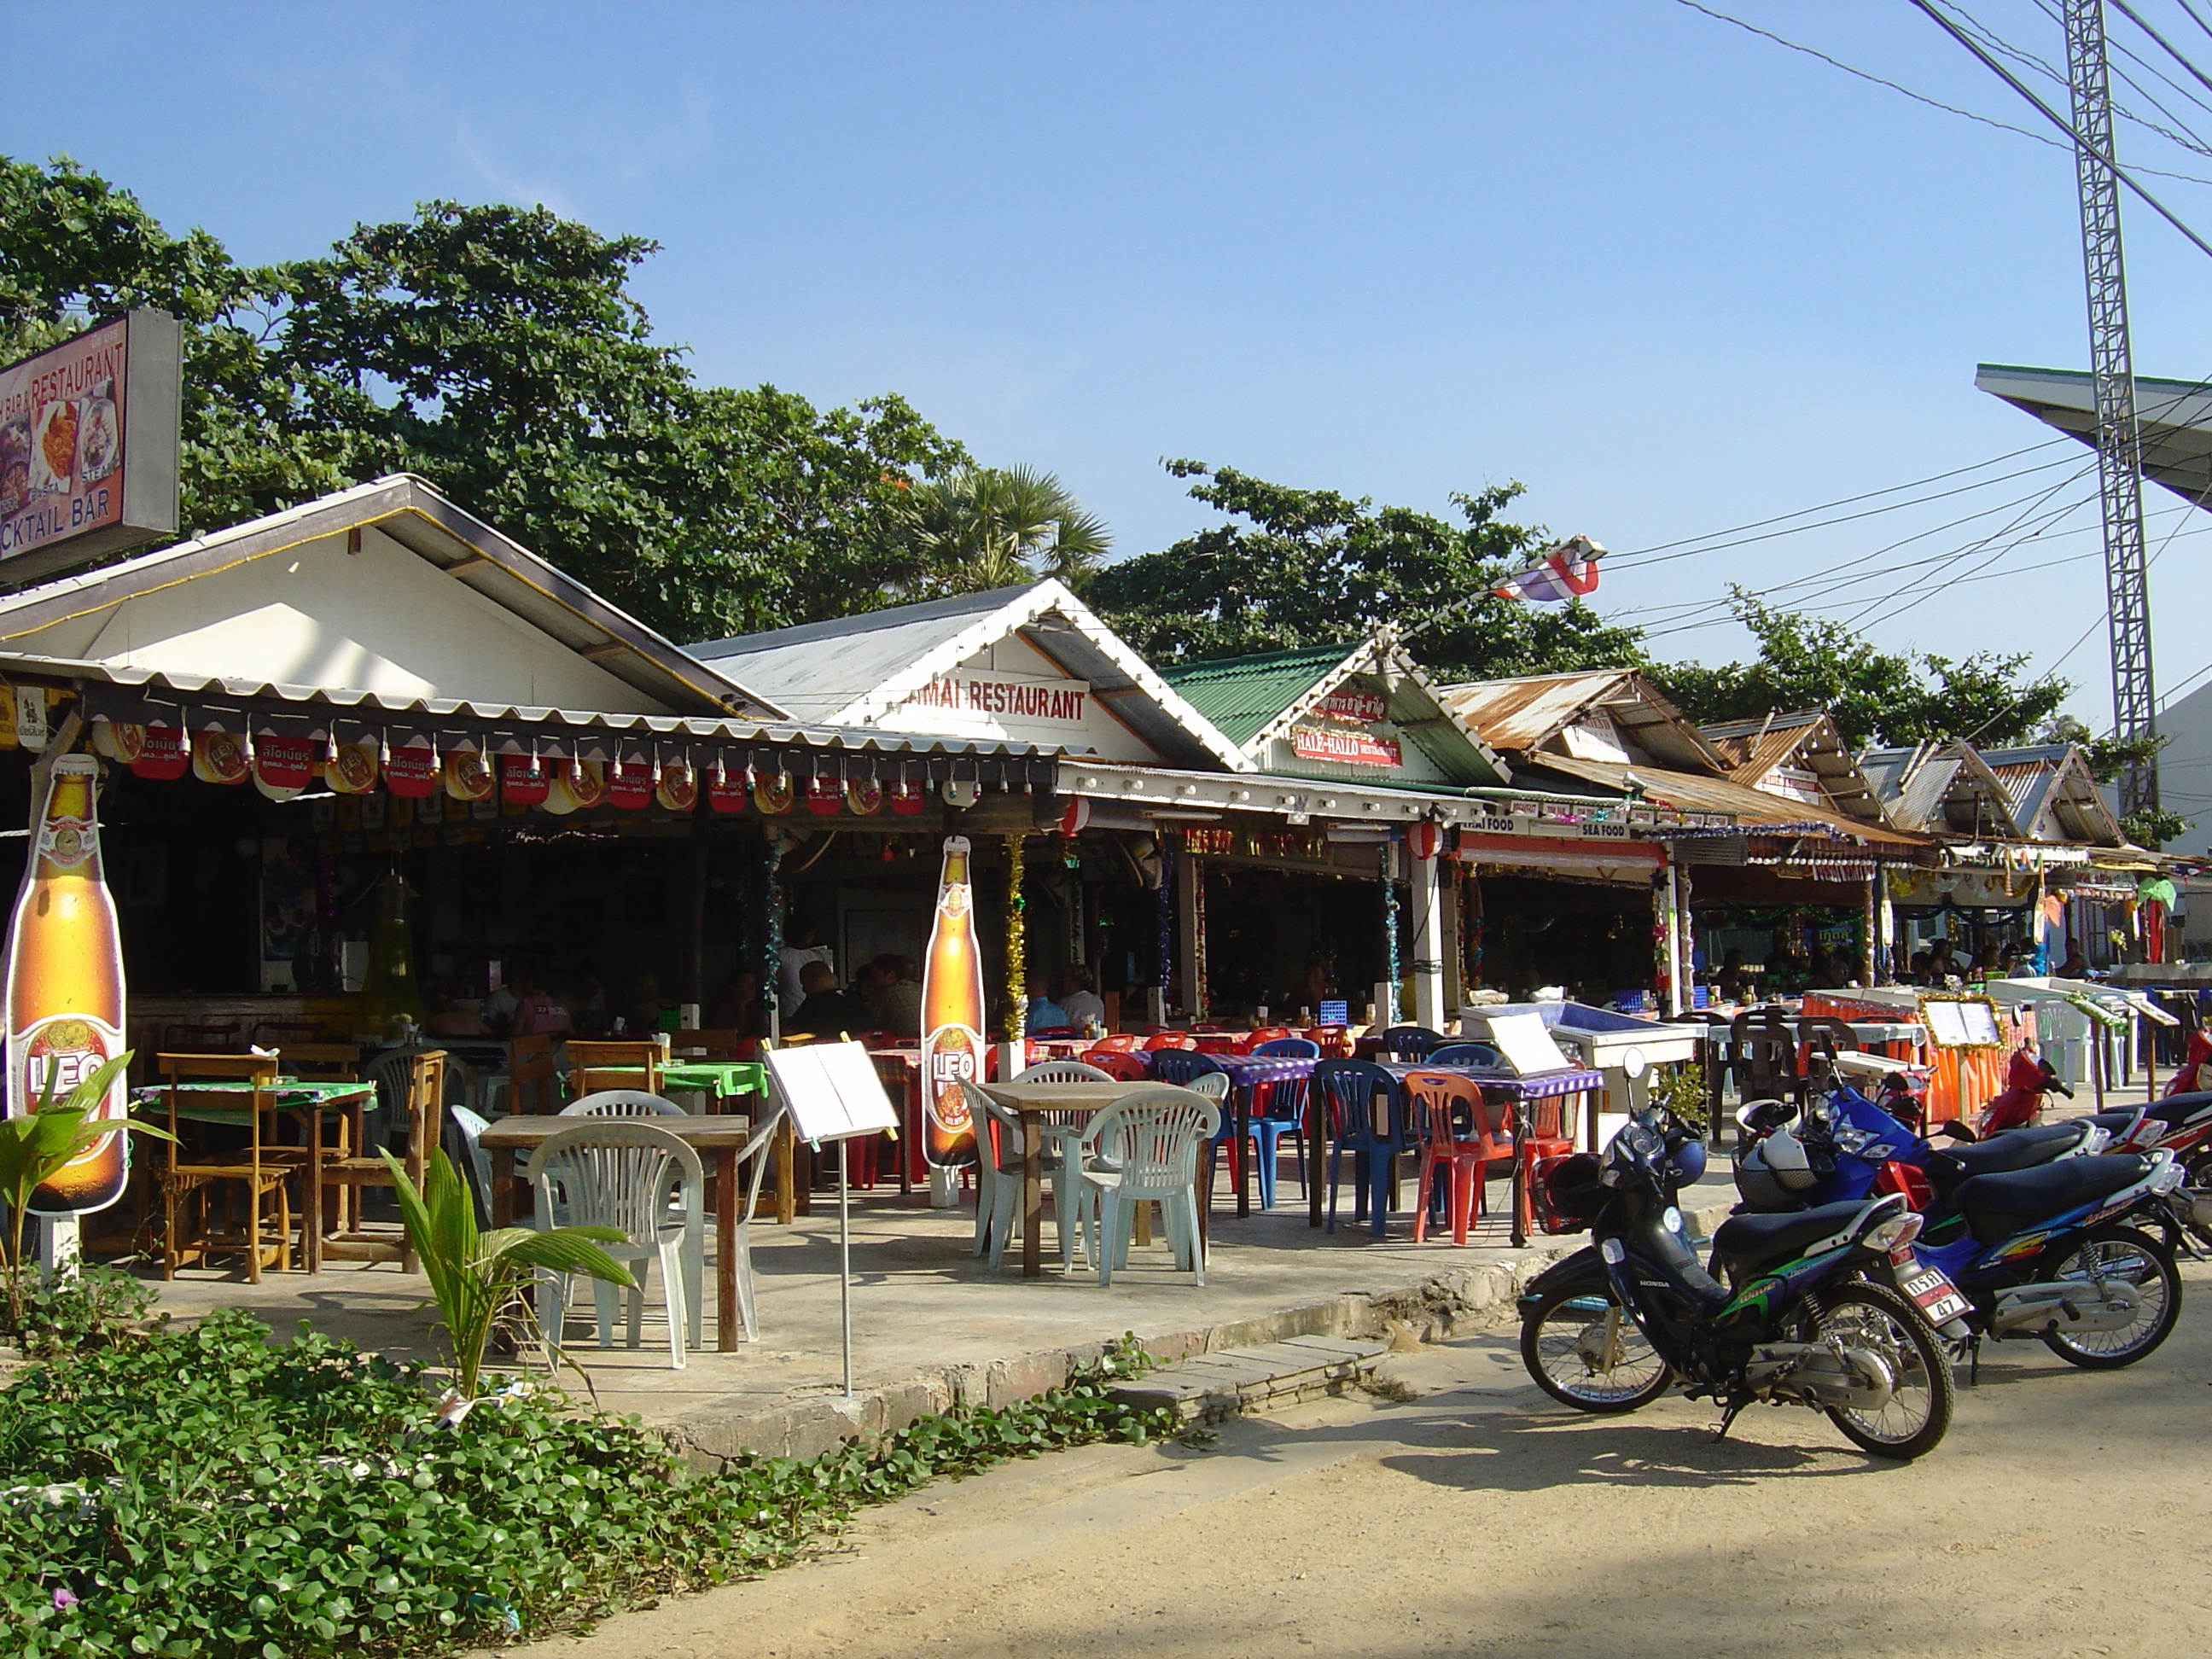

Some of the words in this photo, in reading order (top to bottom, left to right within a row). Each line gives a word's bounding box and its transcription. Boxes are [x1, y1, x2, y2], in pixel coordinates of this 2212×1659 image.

[32, 342, 123, 410] RESTAURANT
[72, 488, 108, 527] BAR
[969, 680, 1086, 720] RESTAURANT
[1297, 733, 1359, 756] HALE-HALLO
[1487, 818, 1514, 831] FOOD
[1582, 824, 1600, 836] SEA
[1601, 825, 1625, 836] FOOD
[933, 1052, 975, 1082] LEO
[1639, 1279, 1670, 1288] HONDA
[1936, 1299, 1955, 1317] 47
